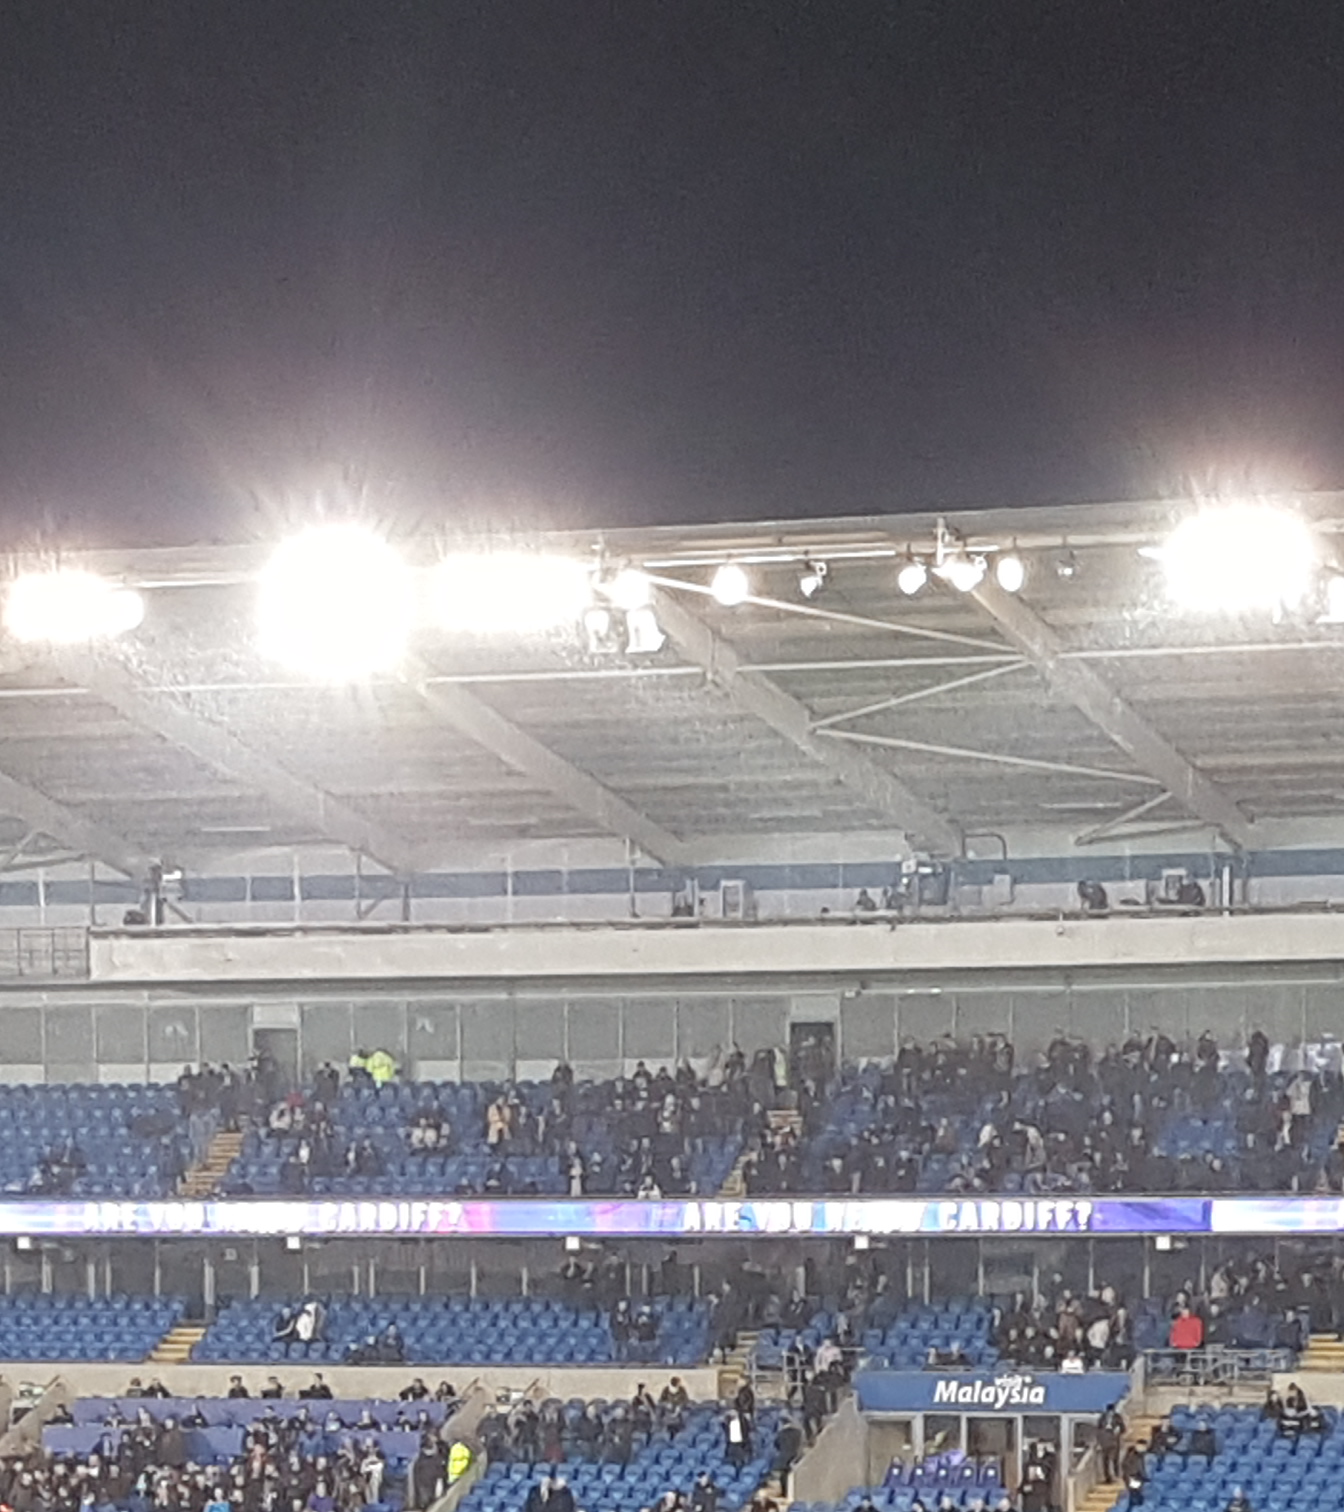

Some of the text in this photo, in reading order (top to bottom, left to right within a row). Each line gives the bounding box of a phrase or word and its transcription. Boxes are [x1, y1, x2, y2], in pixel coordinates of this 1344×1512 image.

[84, 1203, 138, 1231] ARE
[148, 1203, 204, 1231] YOU
[318, 1203, 462, 1231] CARDIFF?
[684, 1201, 741, 1230] ARE
[755, 1201, 813, 1230] YOU
[939, 1201, 1092, 1230] CARDIFF?
[933, 1379, 1045, 1410] Malaysia
